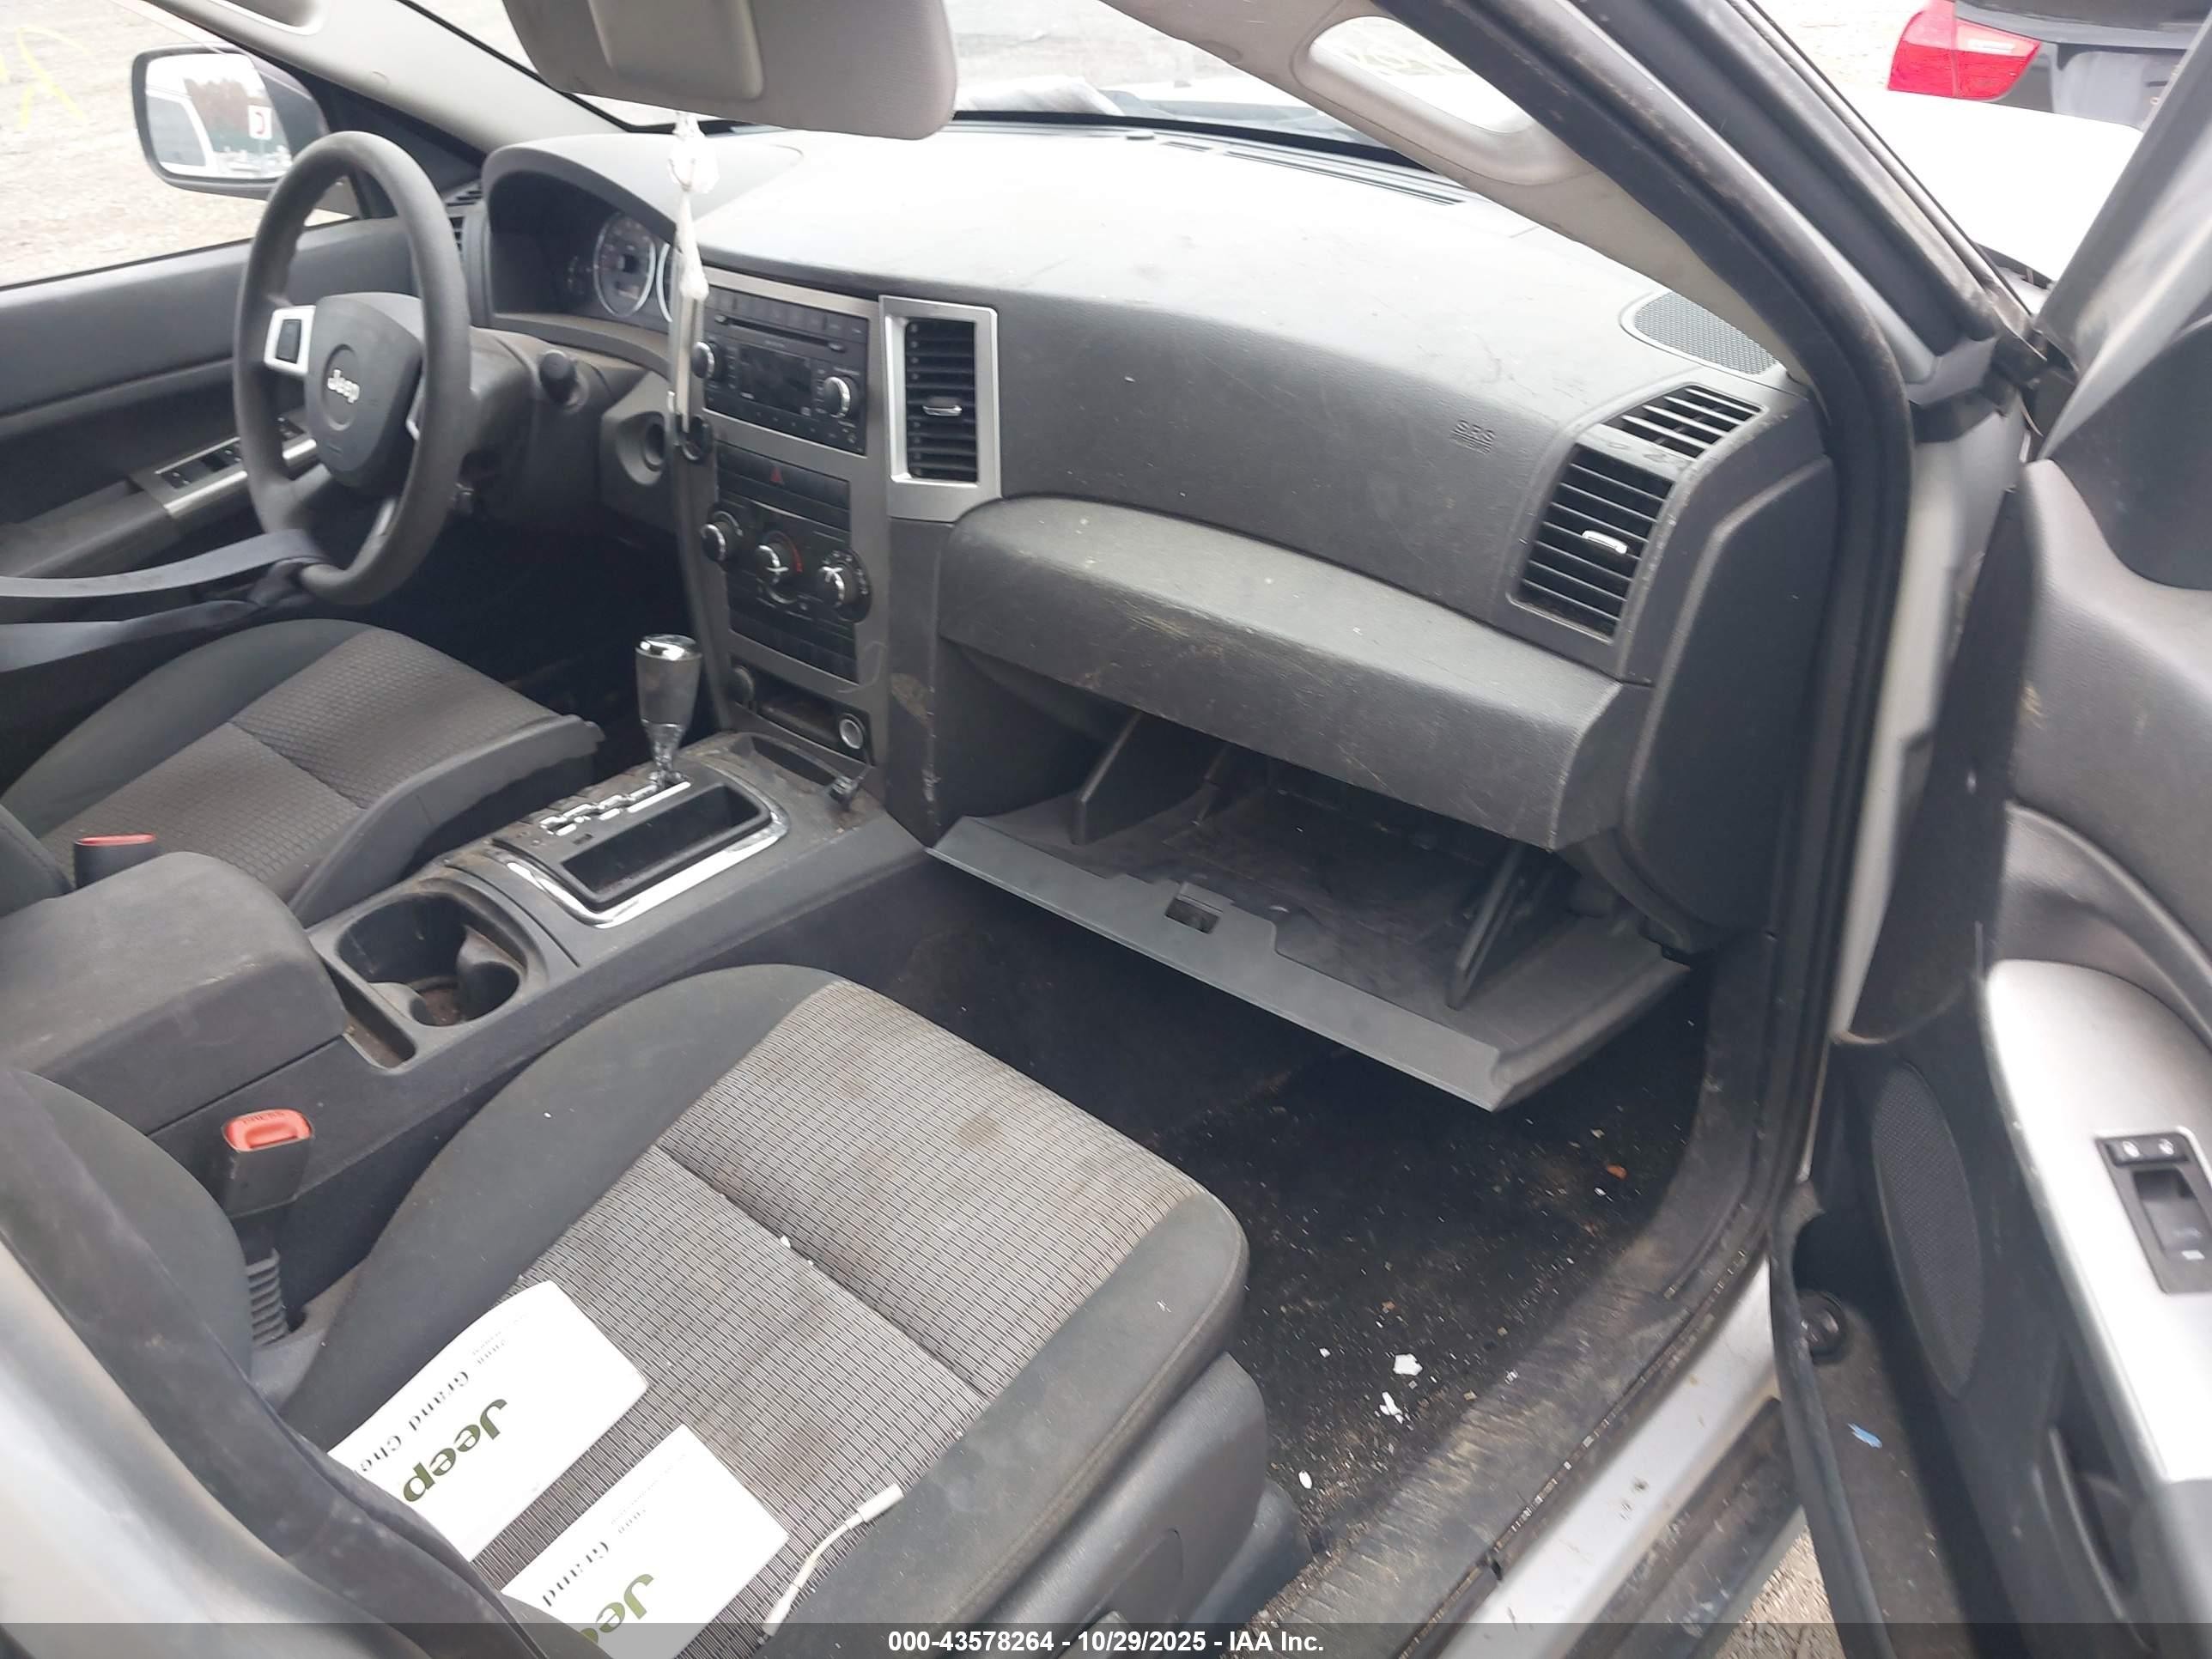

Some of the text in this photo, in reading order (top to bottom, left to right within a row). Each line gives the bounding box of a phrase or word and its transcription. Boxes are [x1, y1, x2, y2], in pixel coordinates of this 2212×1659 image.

[408, 1370, 469, 1432] Grand
[361, 1435, 402, 1472] Che
[404, 1398, 508, 1503] Jeep
[543, 1541, 609, 1607] Grand
